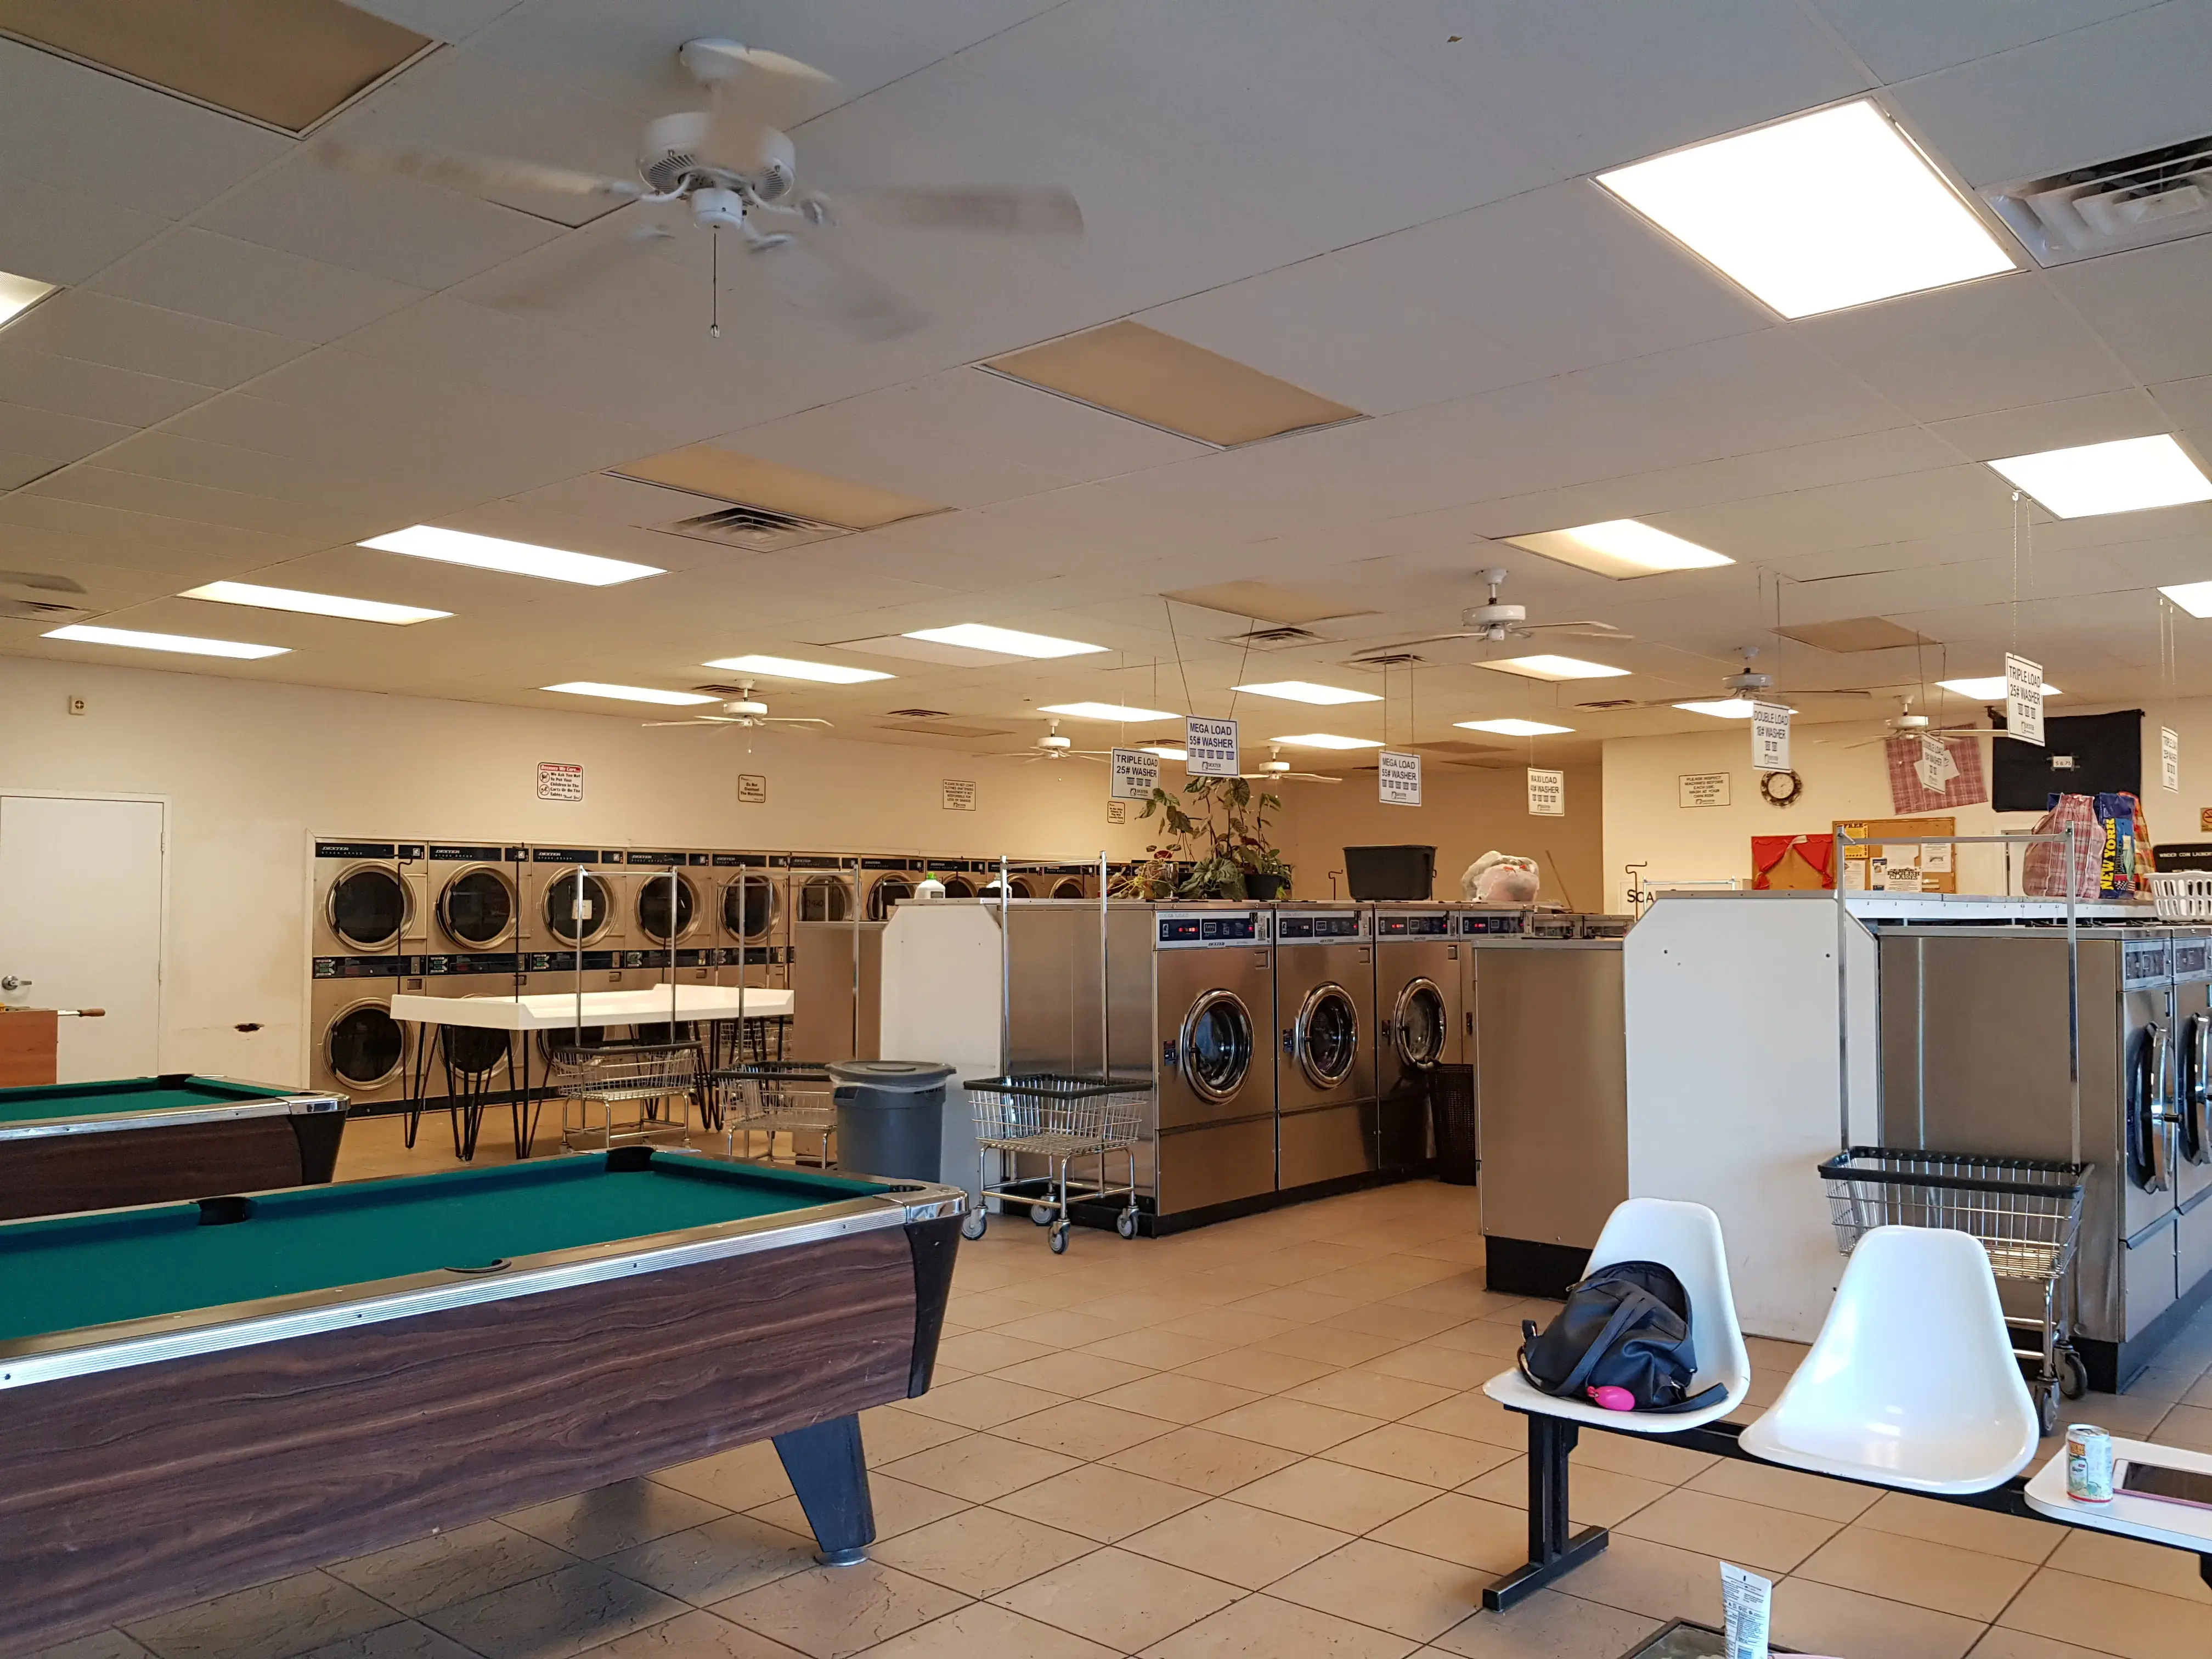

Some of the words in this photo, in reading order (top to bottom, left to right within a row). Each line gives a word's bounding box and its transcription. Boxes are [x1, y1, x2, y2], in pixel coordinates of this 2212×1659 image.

[2009, 665, 2027, 683] TRIPLE
[2028, 673, 2040, 688] LOAD
[2010, 684, 2019, 698] 25#
[2021, 687, 2041, 705] WASHER
[1754, 710, 1774, 723] DOUBLE
[1775, 714, 1788, 725] LOAD
[1190, 723, 1209, 733] MEGA
[1211, 725, 1232, 735] LOAD
[1765, 727, 1786, 740] WASHER
[1189, 736, 1201, 746] 55#
[1202, 737, 1233, 748] WASHER
[1115, 754, 1142, 765] TRIPLE
[1143, 758, 1158, 767] LOAD
[1383, 757, 1397, 768] MEGA
[1398, 760, 1415, 769] LOAD
[1116, 765, 1130, 775] 25#
[1132, 767, 1157, 778] WASHER
[1392, 770, 1417, 780] WASHER
[1542, 776, 1557, 784] LOAD
[1538, 786, 1560, 794] WASHER
[2104, 818, 2116, 858] YORK
[2100, 859, 2115, 890] NEW
